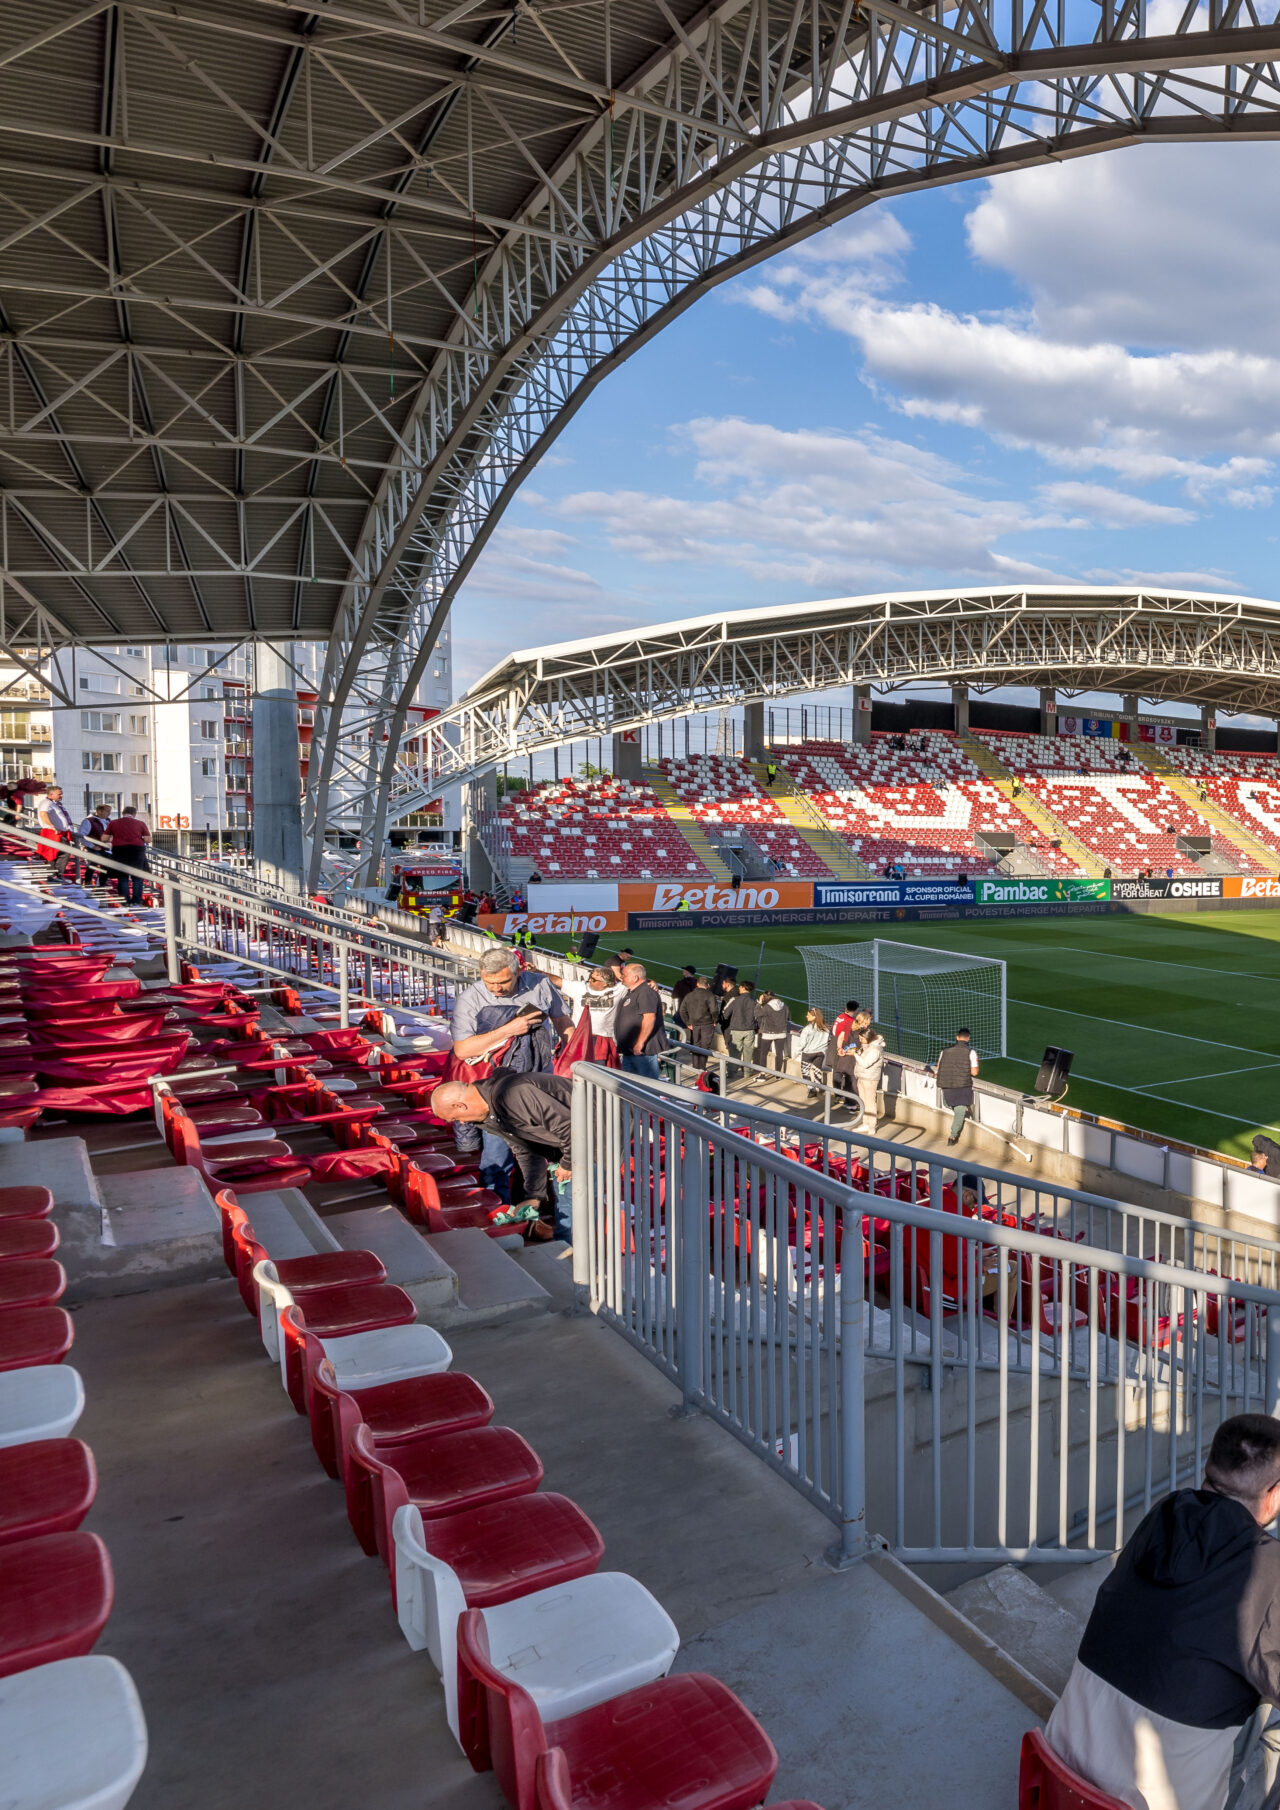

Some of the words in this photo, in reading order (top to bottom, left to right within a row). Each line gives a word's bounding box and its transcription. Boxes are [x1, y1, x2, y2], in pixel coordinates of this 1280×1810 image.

[860, 701, 868, 710] L
[1047, 704, 1056, 713] M
[1208, 720, 1216, 729] N
[623, 730, 637, 743] K
[160, 815, 190, 829] R13
[983, 882, 1048, 901] Pambac
[1113, 883, 1149, 892] HYDRATE
[1127, 890, 1138, 898] FOR
[1139, 889, 1163, 898] GREAT
[1171, 882, 1220, 897] OSHEE
[652, 884, 779, 911] Betano
[938, 893, 974, 901] ROMÂNIEI
[503, 914, 607, 934] Betano
[702, 914, 770, 925] POVESTEA
[771, 913, 814, 923] MERGE
[816, 912, 837, 922] MAI
[837, 911, 890, 921] DEPARTE
